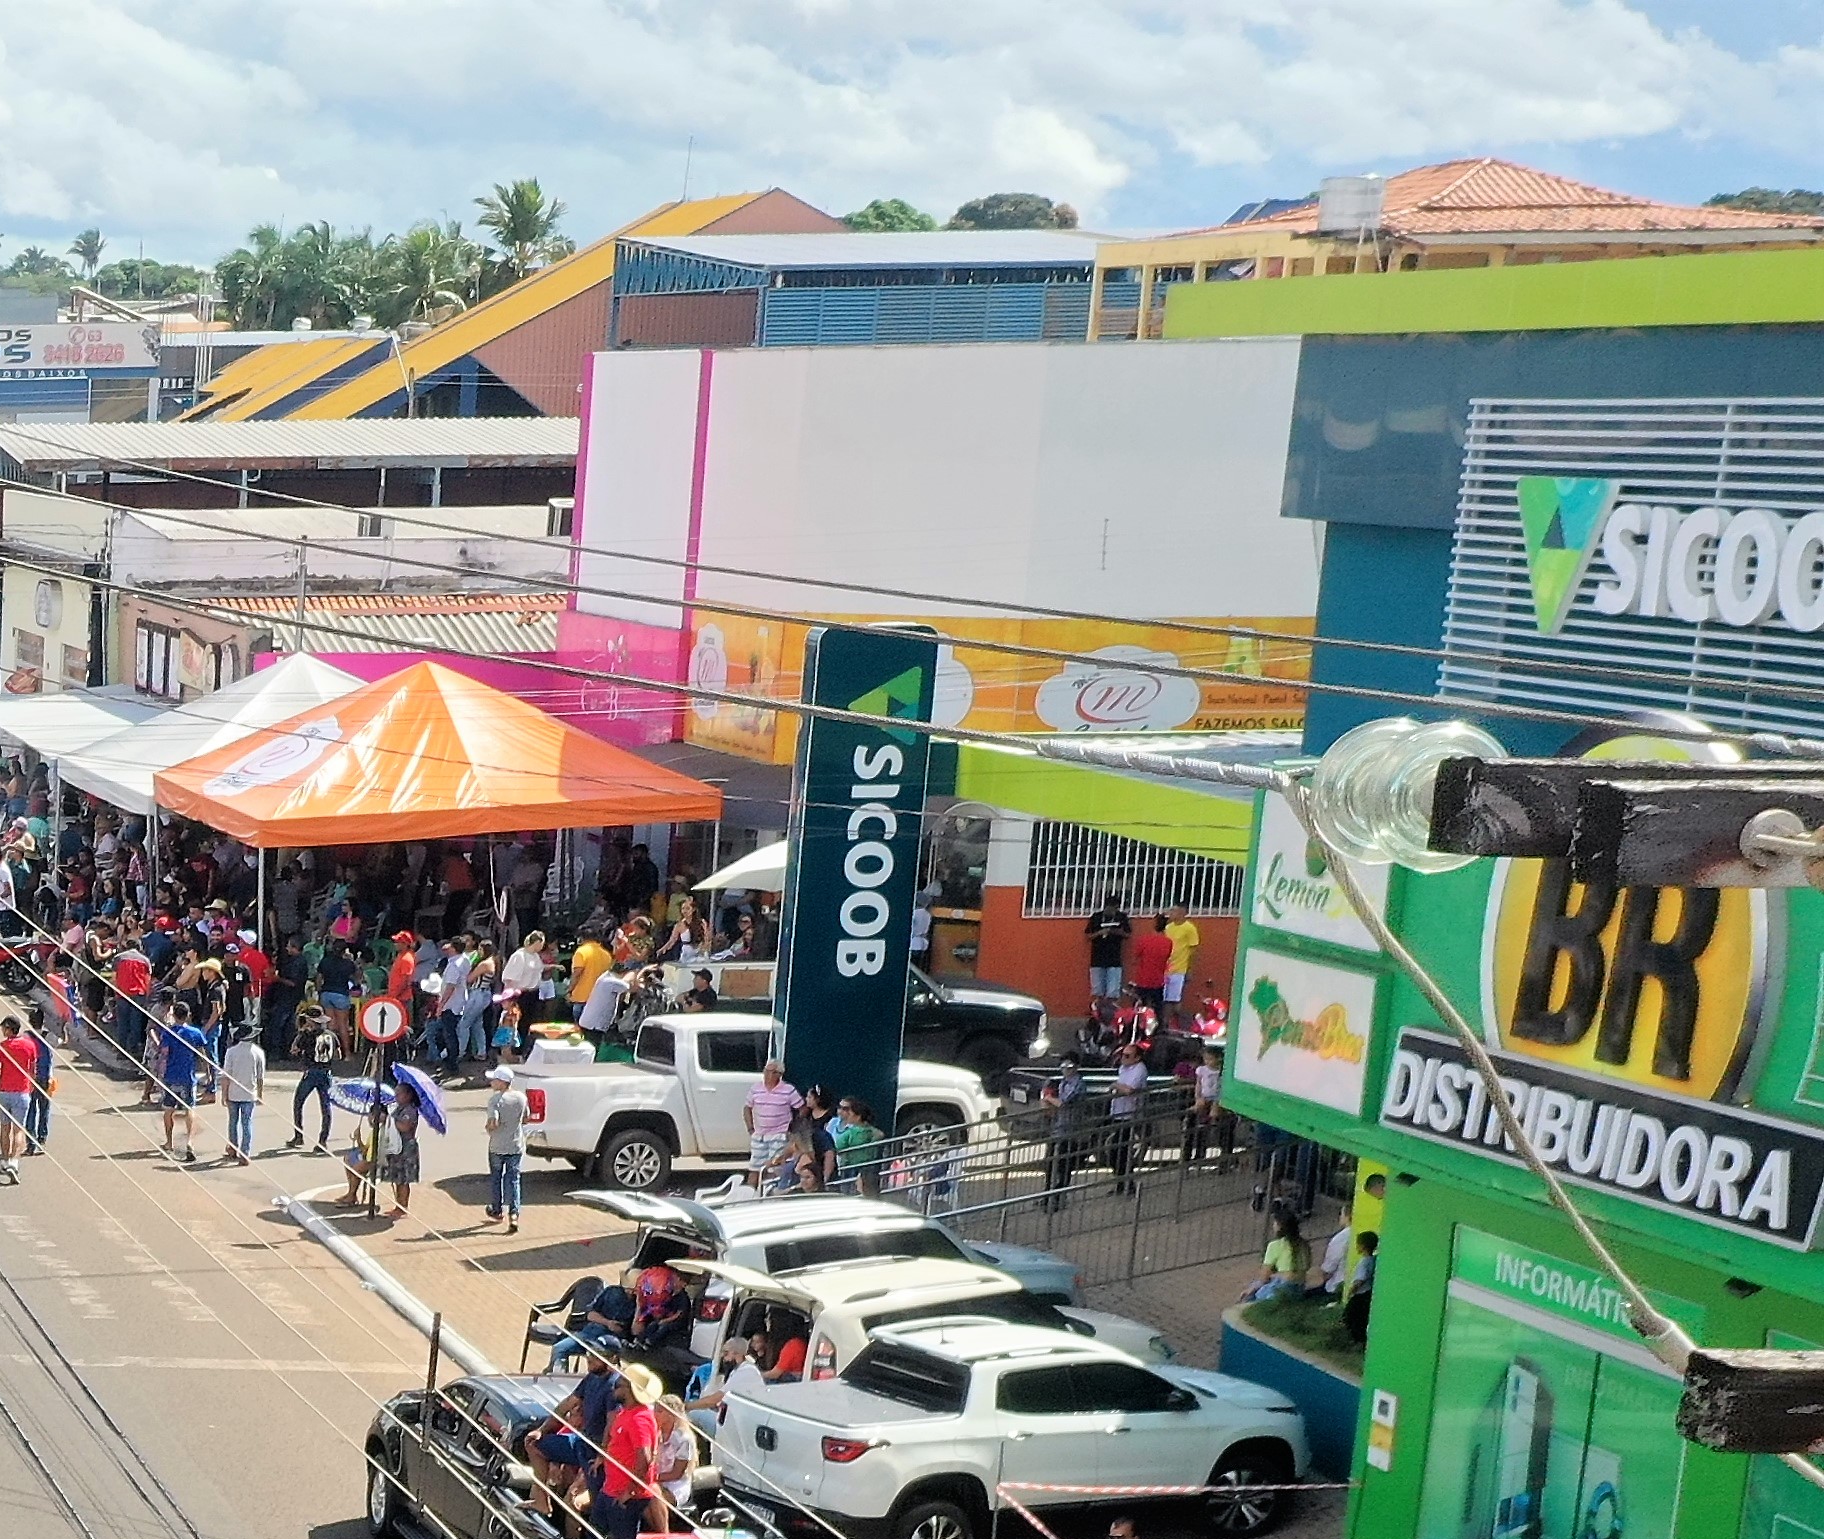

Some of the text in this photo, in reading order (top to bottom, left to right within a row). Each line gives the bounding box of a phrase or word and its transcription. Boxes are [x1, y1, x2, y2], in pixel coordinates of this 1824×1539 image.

[1195, 717, 1266, 731] FAZEMOS
[834, 742, 904, 979] SICOOB
[1258, 851, 1331, 920] Lemon
[1511, 857, 1721, 1082] BR
[1386, 1049, 1792, 1231] DISTRIBUIDORA
[1495, 1251, 1632, 1328] INFORMÁTI
